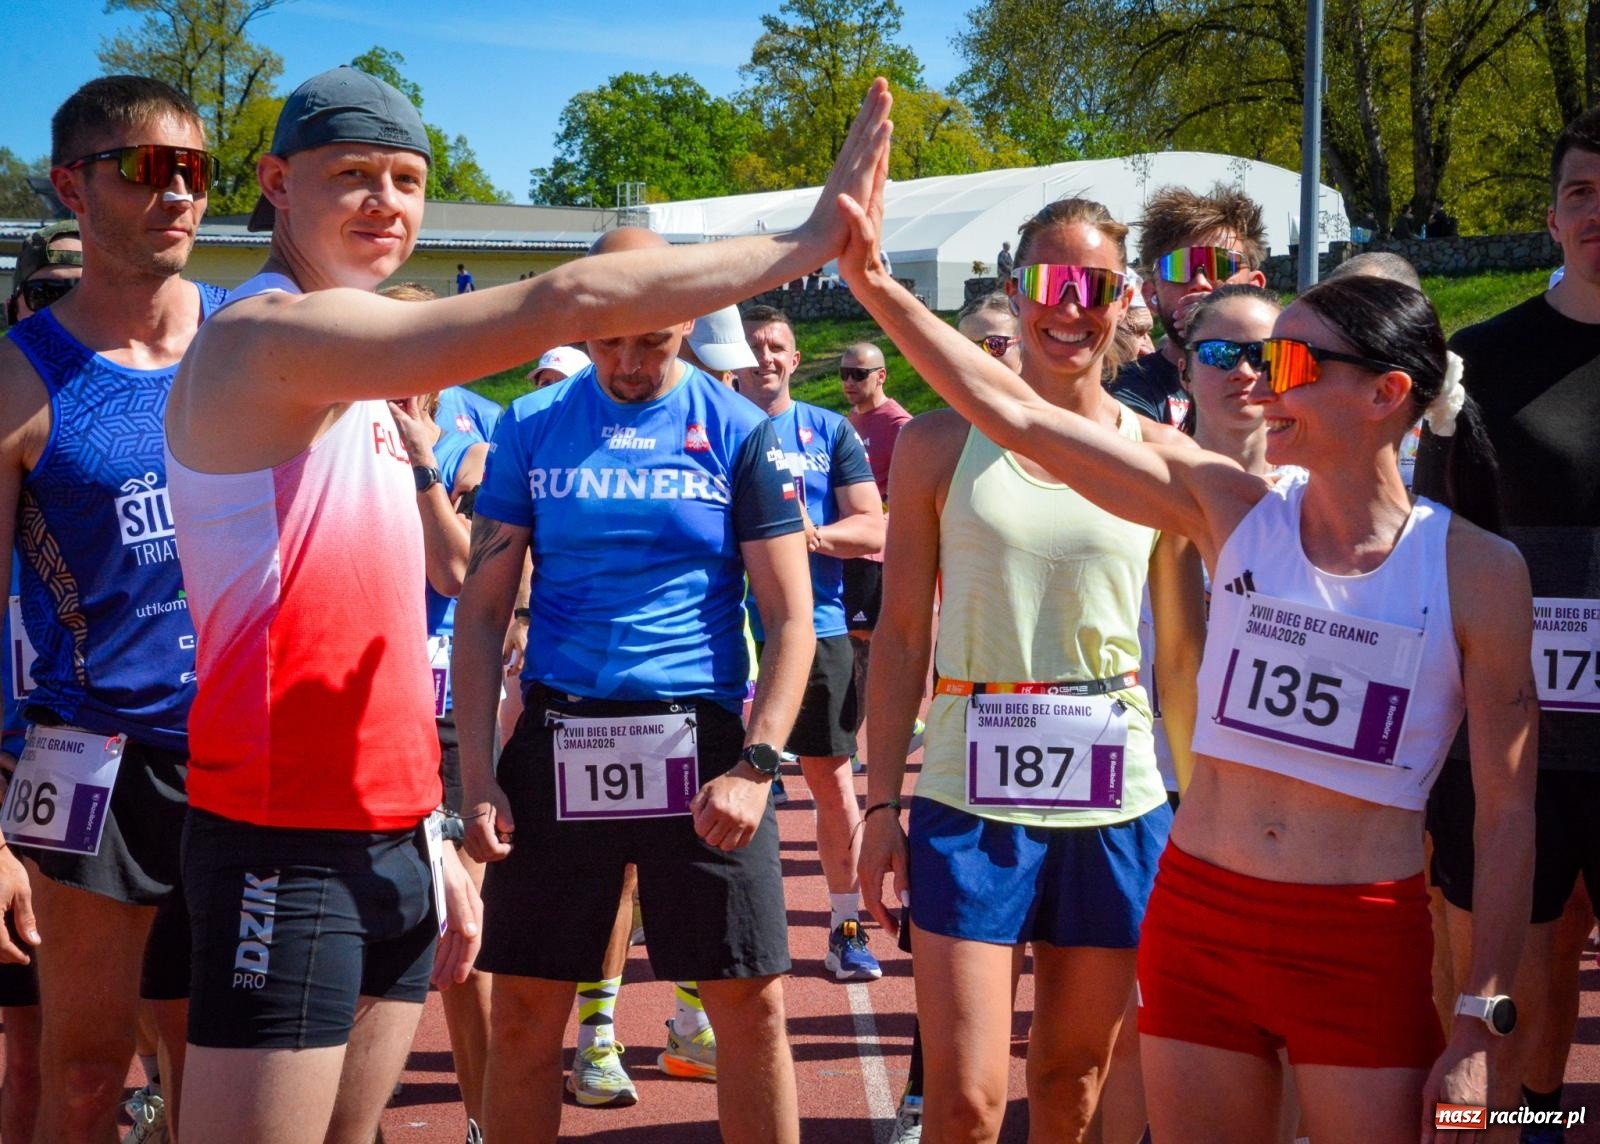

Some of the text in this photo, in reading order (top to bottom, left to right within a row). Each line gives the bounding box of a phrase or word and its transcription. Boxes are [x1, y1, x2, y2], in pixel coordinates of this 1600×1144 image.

[528, 467, 732, 505] RUNNERS
[1555, 607, 1580, 619] BIEG
[1246, 620, 1307, 646] 3MAJA2026
[1250, 604, 1379, 646] XVIII BIEG BEZ GRANIC
[1532, 620, 1588, 632] MAJA2026
[1248, 658, 1343, 727] 135
[977, 703, 1092, 717] XVIII BIEG BEZ GRANIC
[563, 724, 665, 738] XVIII BIEG BEZ GRANIC
[978, 717, 1037, 728] 3MAJA2026
[47, 738, 85, 754] GRANIC
[563, 738, 616, 750] 3MAJA2026
[994, 745, 1075, 788] 187
[585, 763, 644, 801] 191
[7, 778, 58, 826] 186
[234, 869, 280, 974] DZIK
[232, 973, 266, 990] PRO
